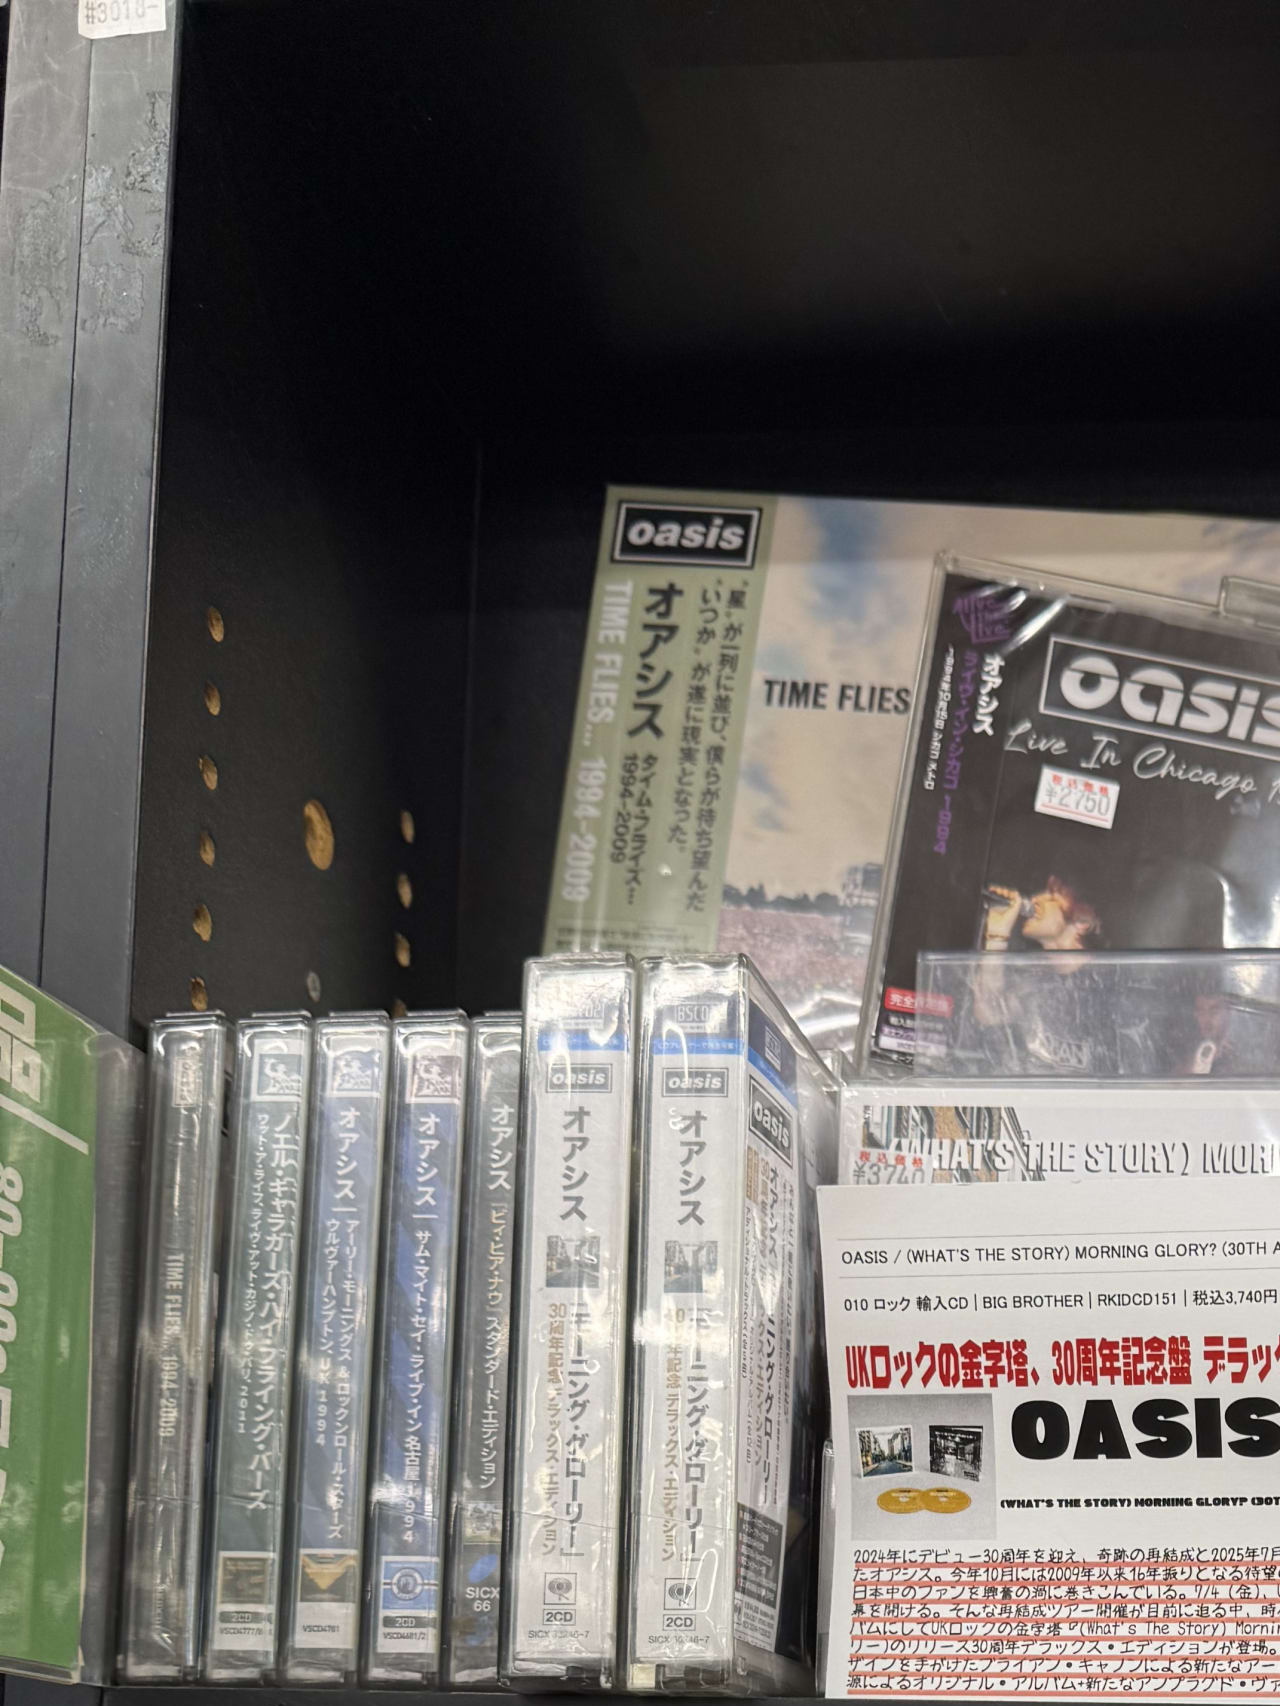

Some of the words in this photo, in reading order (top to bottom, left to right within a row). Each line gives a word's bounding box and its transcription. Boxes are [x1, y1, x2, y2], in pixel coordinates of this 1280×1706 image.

[626, 518, 746, 552] oasis
[598, 579, 634, 644] TIME
[627, 582, 684, 740] オアシス
[764, 680, 827, 709] TIME
[838, 683, 911, 716] FLIES
[973, 652, 1005, 736] オアシス
[1004, 722, 1068, 755] Live
[1081, 734, 1121, 770] In
[1132, 746, 1257, 798] Chicago
[1045, 781, 1112, 818] ¥2750
[562, 756, 607, 901] 1994-2009
[552, 1071, 606, 1087] oasis
[334, 1107, 360, 1199] オアシス
[414, 1112, 441, 1206] オアシス
[489, 1105, 514, 1191] オアシス
[560, 1106, 591, 1222] オアシス
[1022, 1139, 1077, 1173] THE
[1084, 1142, 1190, 1177] STORY)
[842, 1251, 887, 1264] OASIS
[907, 1249, 969, 1264] (WHAT'S
[975, 1248, 1005, 1261] THE
[1012, 1246, 1069, 1261] STORY)
[1076, 1245, 1148, 1259] MORNING
[1155, 1243, 1216, 1257] GLORY?
[1223, 1242, 1266, 1256] (30TH
[844, 1299, 868, 1311] 010
[874, 1297, 910, 1311] ロック
[917, 1296, 968, 1311] 輸入CD
[983, 1296, 1007, 1308] BIG
[1013, 1295, 1083, 1308] BROTHER
[1098, 1293, 1175, 1306] RKIDCD151
[546, 1611, 573, 1624] 2CD
[1146, 1621, 1170, 1634] The
[1178, 1621, 1227, 1637] Story)
